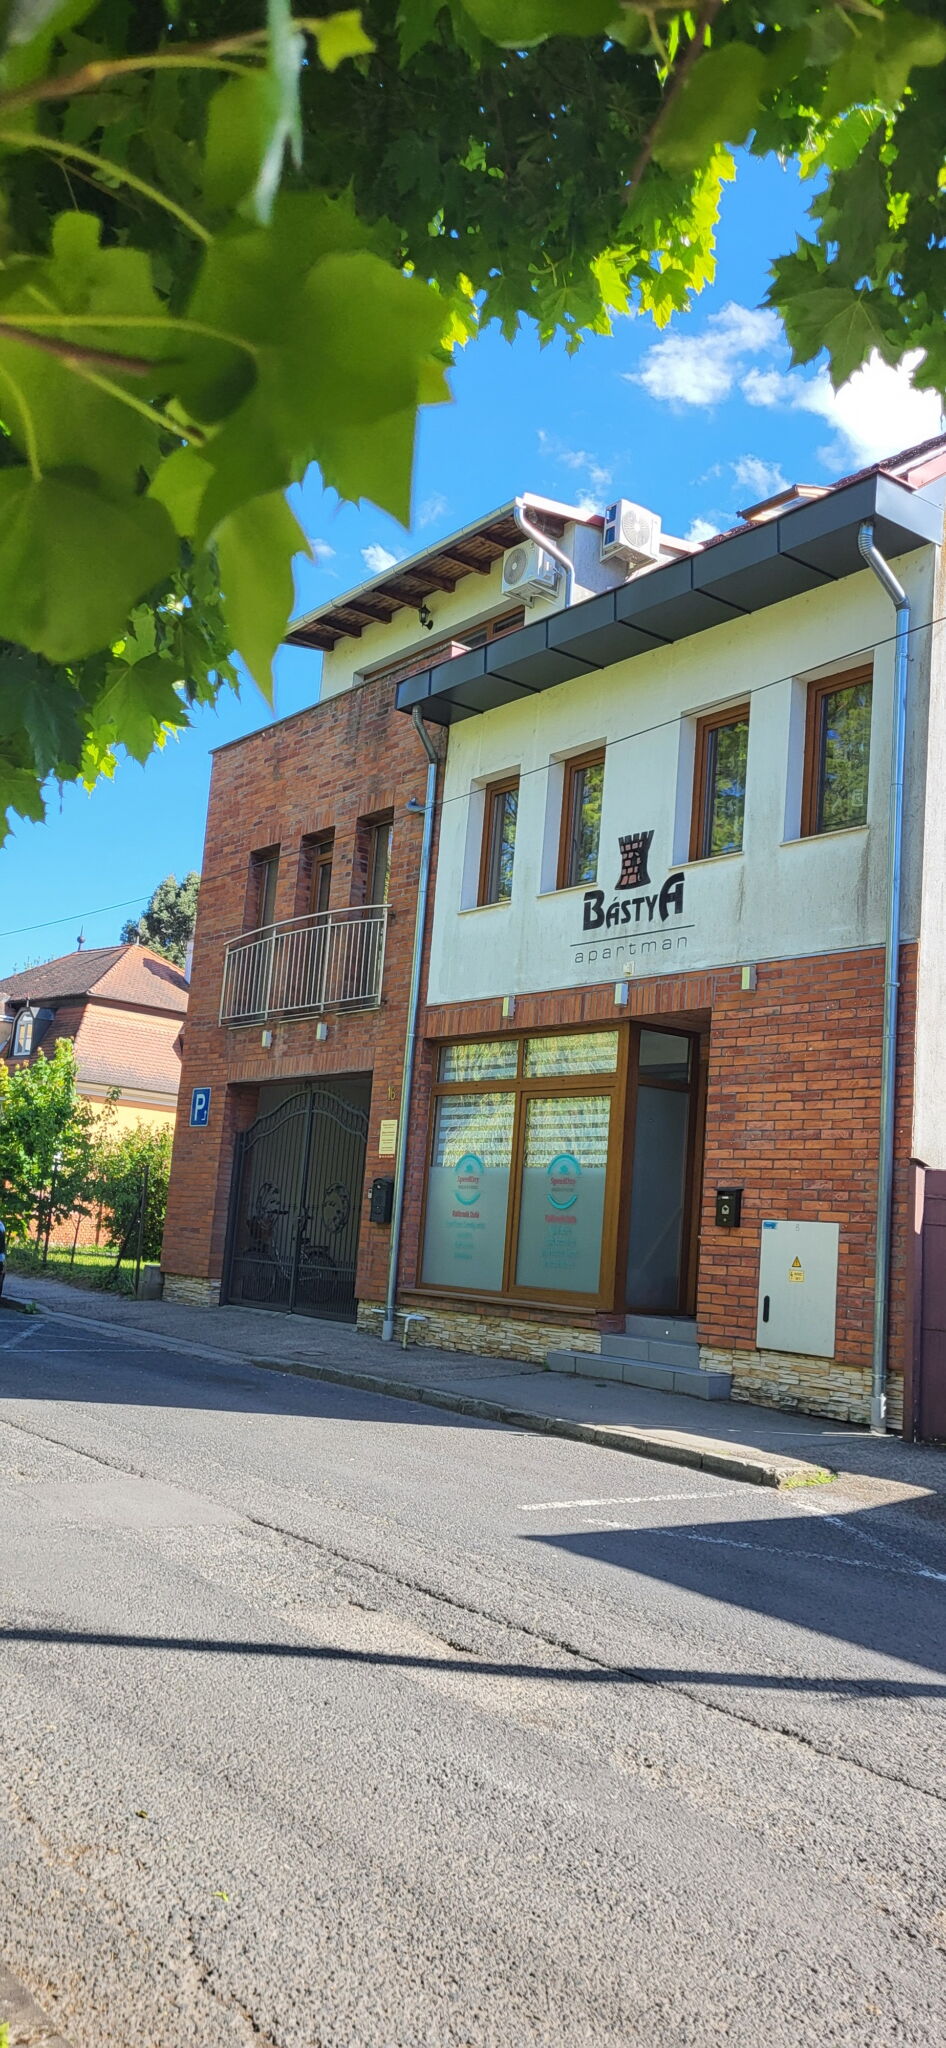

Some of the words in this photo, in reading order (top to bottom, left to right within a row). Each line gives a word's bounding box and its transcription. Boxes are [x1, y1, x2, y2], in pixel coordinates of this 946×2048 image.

[583, 872, 685, 931] BÁSTYA
[574, 937, 688, 964] apartman
[194, 1093, 206, 1121] P
[387, 1086, 396, 1101] 16
